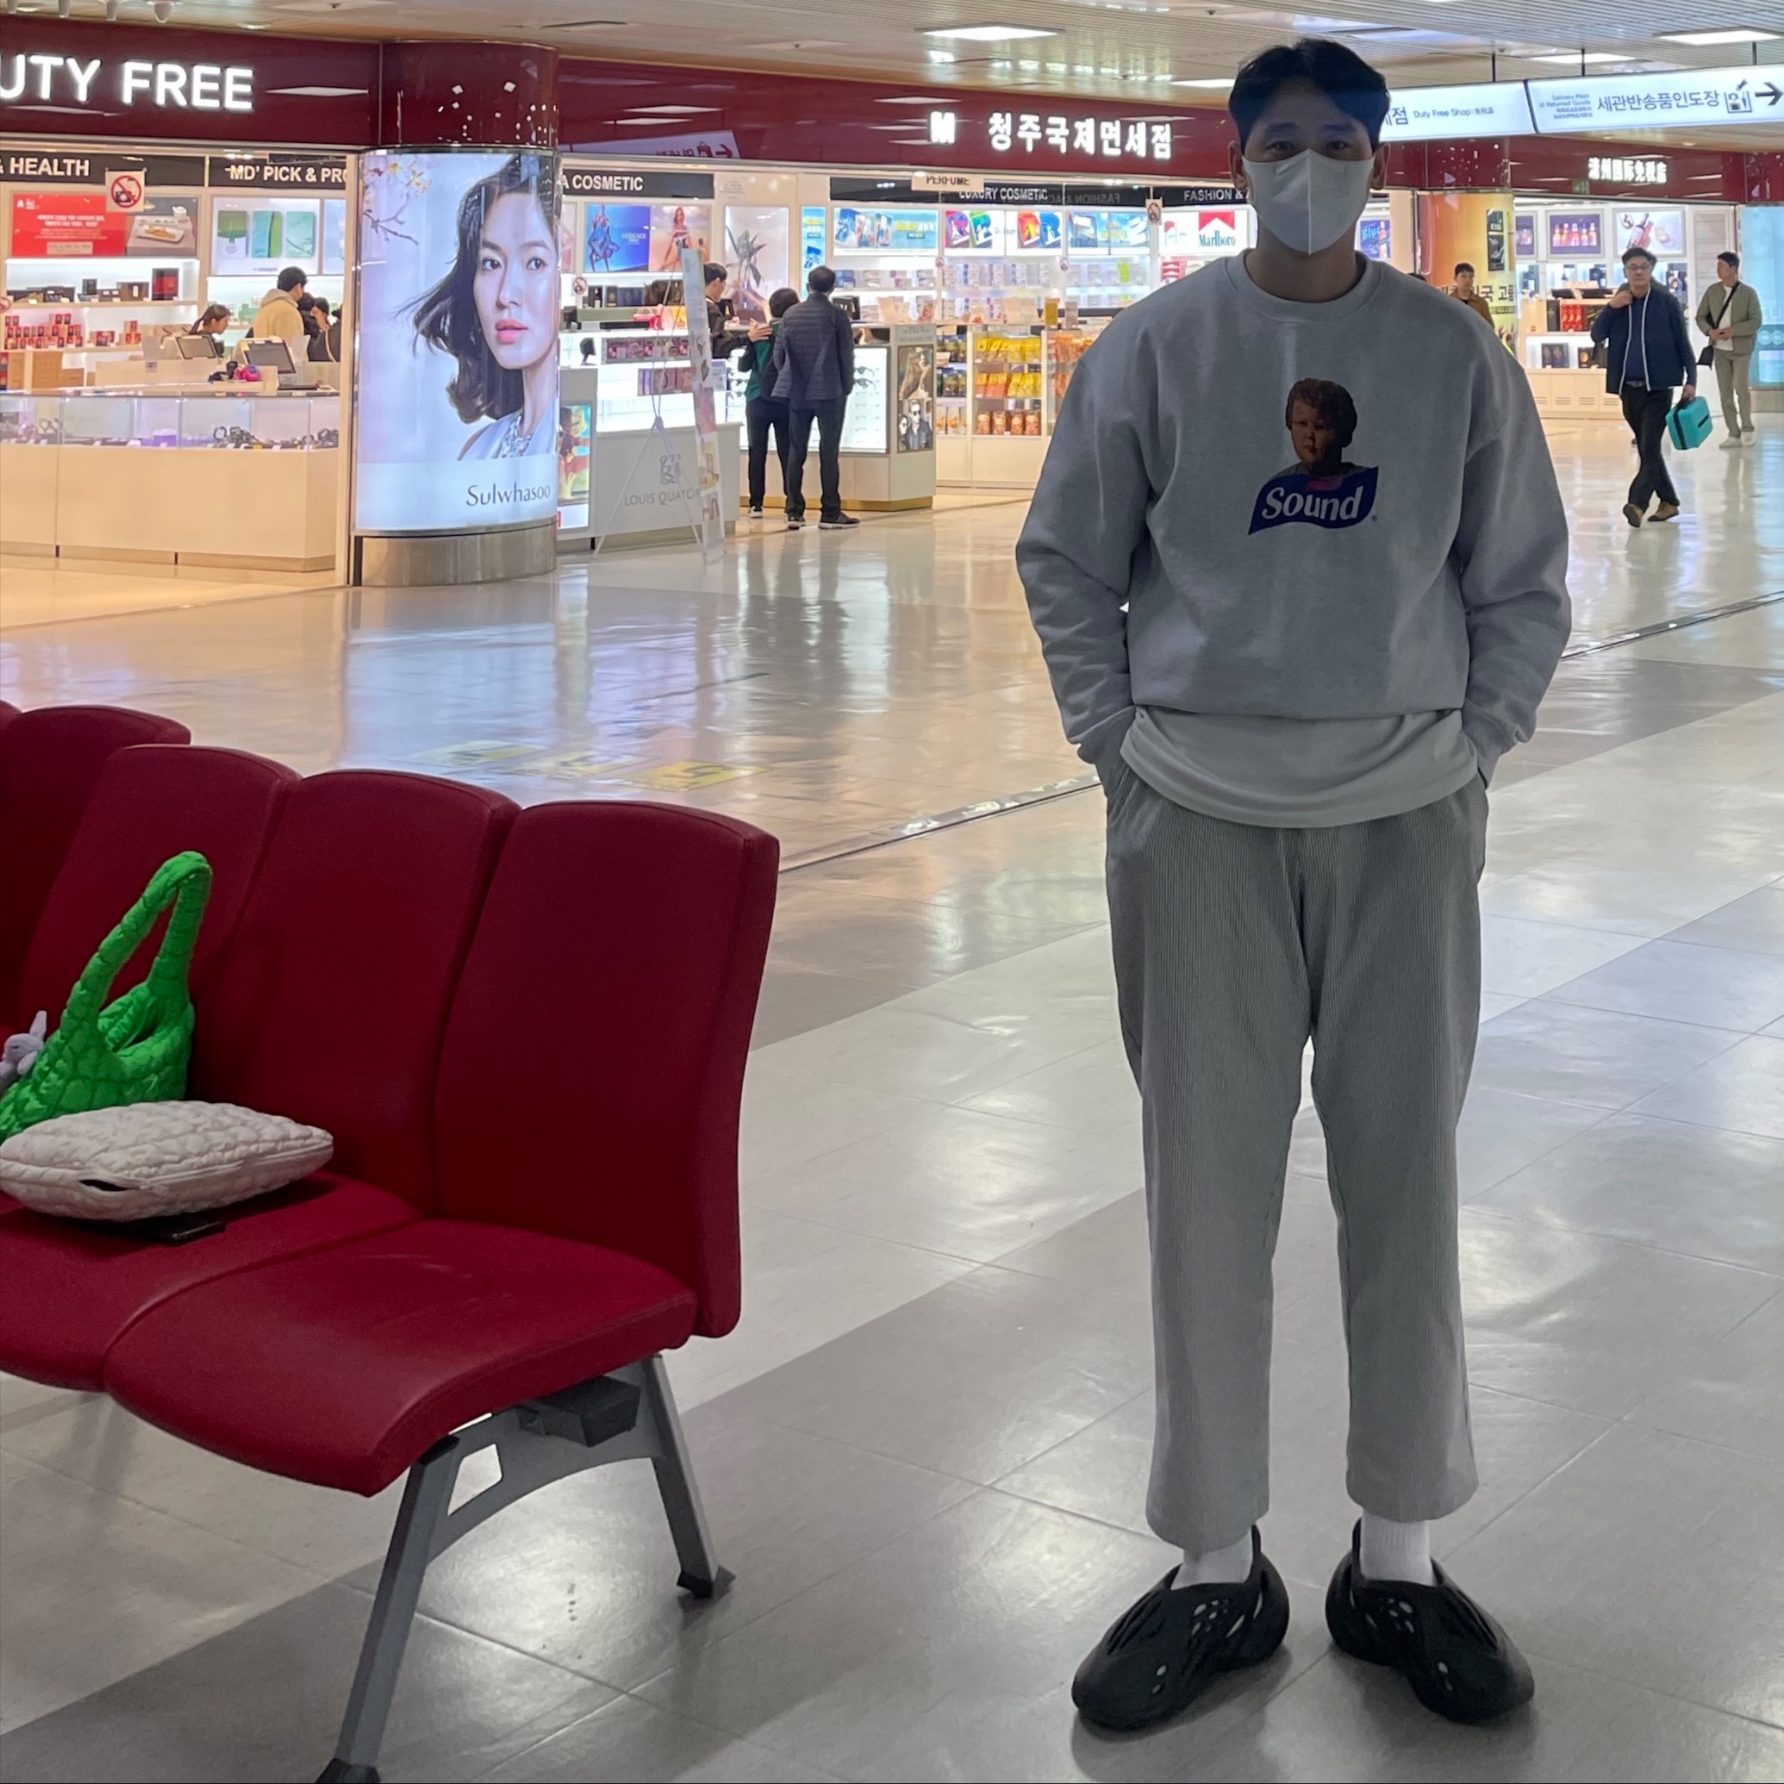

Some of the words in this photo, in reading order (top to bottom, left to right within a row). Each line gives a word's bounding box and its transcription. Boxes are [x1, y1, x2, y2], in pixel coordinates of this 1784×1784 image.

[122, 61, 254, 110] FREE
[1597, 90, 1720, 113] 세관반송품인도장
[1413, 110, 1430, 119] Duty
[1432, 109, 1449, 117] Free
[1451, 107, 1471, 117] Shop
[988, 112, 1172, 160] 청주국제면세점
[9, 157, 90, 177] HEALTH
[263, 165, 302, 181] PICK
[305, 166, 317, 182] &
[572, 175, 644, 191] COSMETIC
[926, 176, 970, 185] PERFUME
[1000, 187, 1048, 201] COSMETIC
[1184, 189, 1232, 201] FASHION
[1199, 230, 1236, 246] Marlboro
[466, 481, 551, 507] Sulwhasoo
[624, 493, 655, 506] LOUIS
[1261, 485, 1364, 521] Sound
